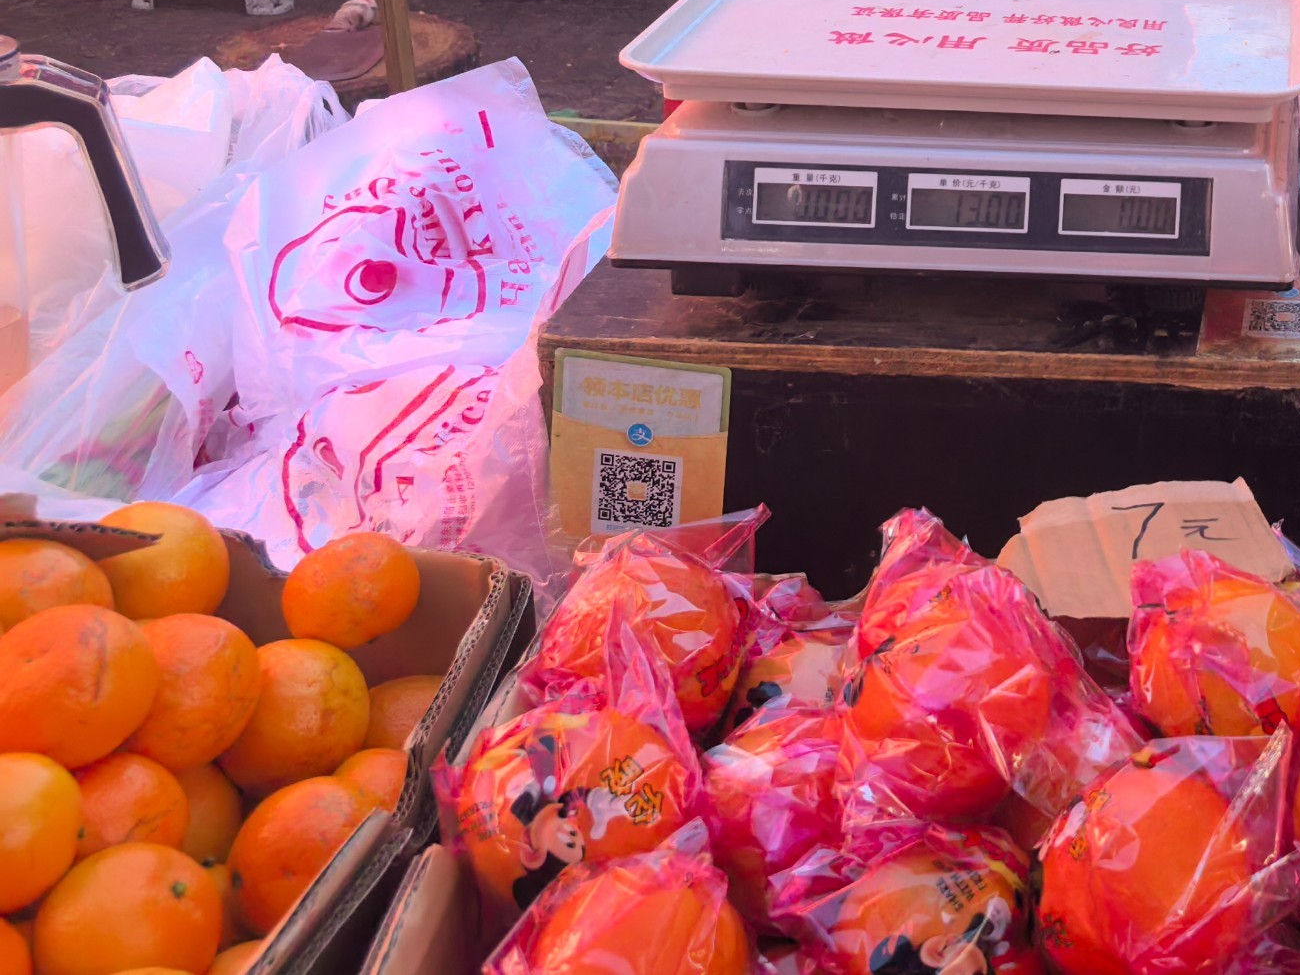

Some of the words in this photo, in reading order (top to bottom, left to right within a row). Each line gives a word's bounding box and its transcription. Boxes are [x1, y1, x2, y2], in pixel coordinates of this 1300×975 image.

[828, 30, 988, 51] 用心做
[1007, 37, 1163, 57] 好品质
[1111, 502, 1240, 559] 7元
